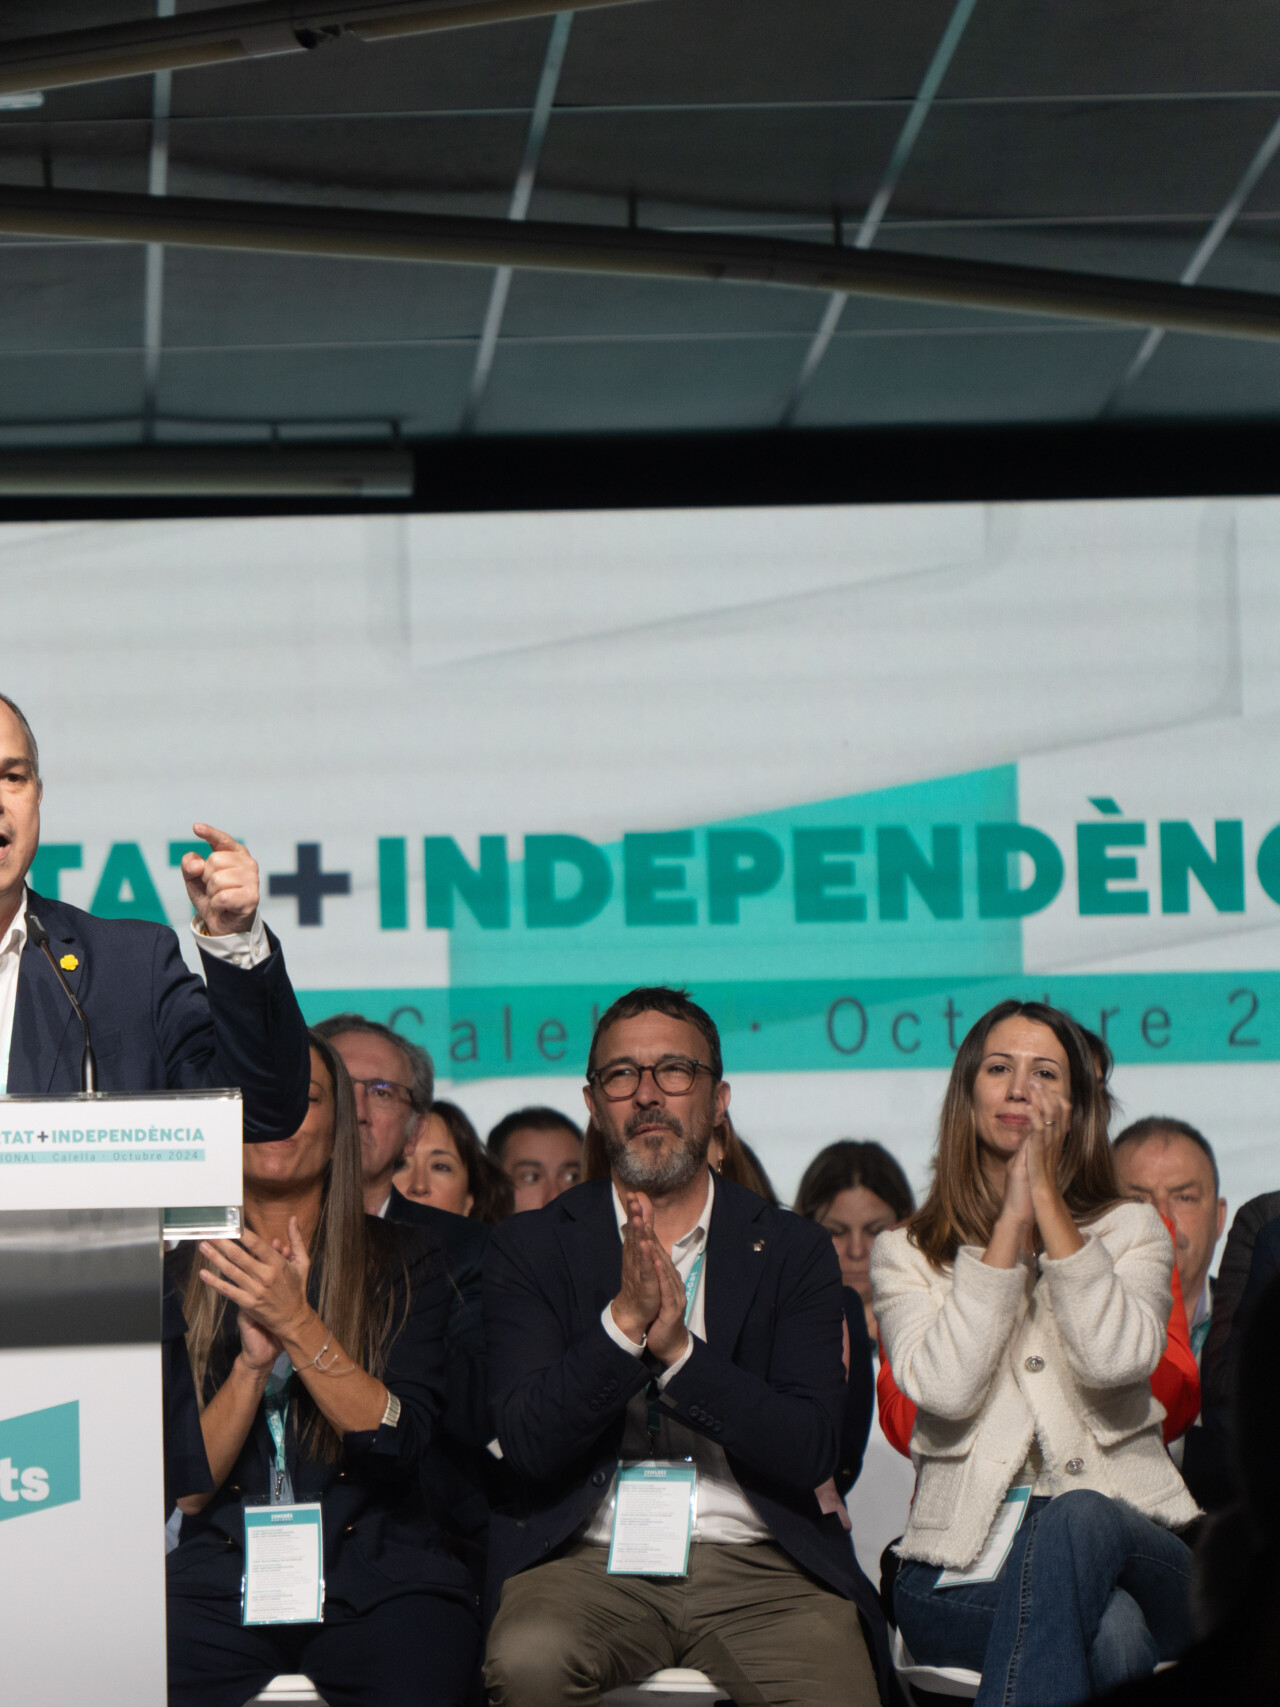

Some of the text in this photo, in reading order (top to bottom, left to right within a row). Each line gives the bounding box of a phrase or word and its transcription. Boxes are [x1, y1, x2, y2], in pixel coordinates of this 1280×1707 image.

[377, 796, 1280, 930] INDEPENDÈN
[52, 1125, 205, 1143] INDEPENDÈNCIA
[52, 1151, 96, 1162] Calella
[112, 1150, 163, 1162] Octubre
[168, 1150, 199, 1161] 2024
